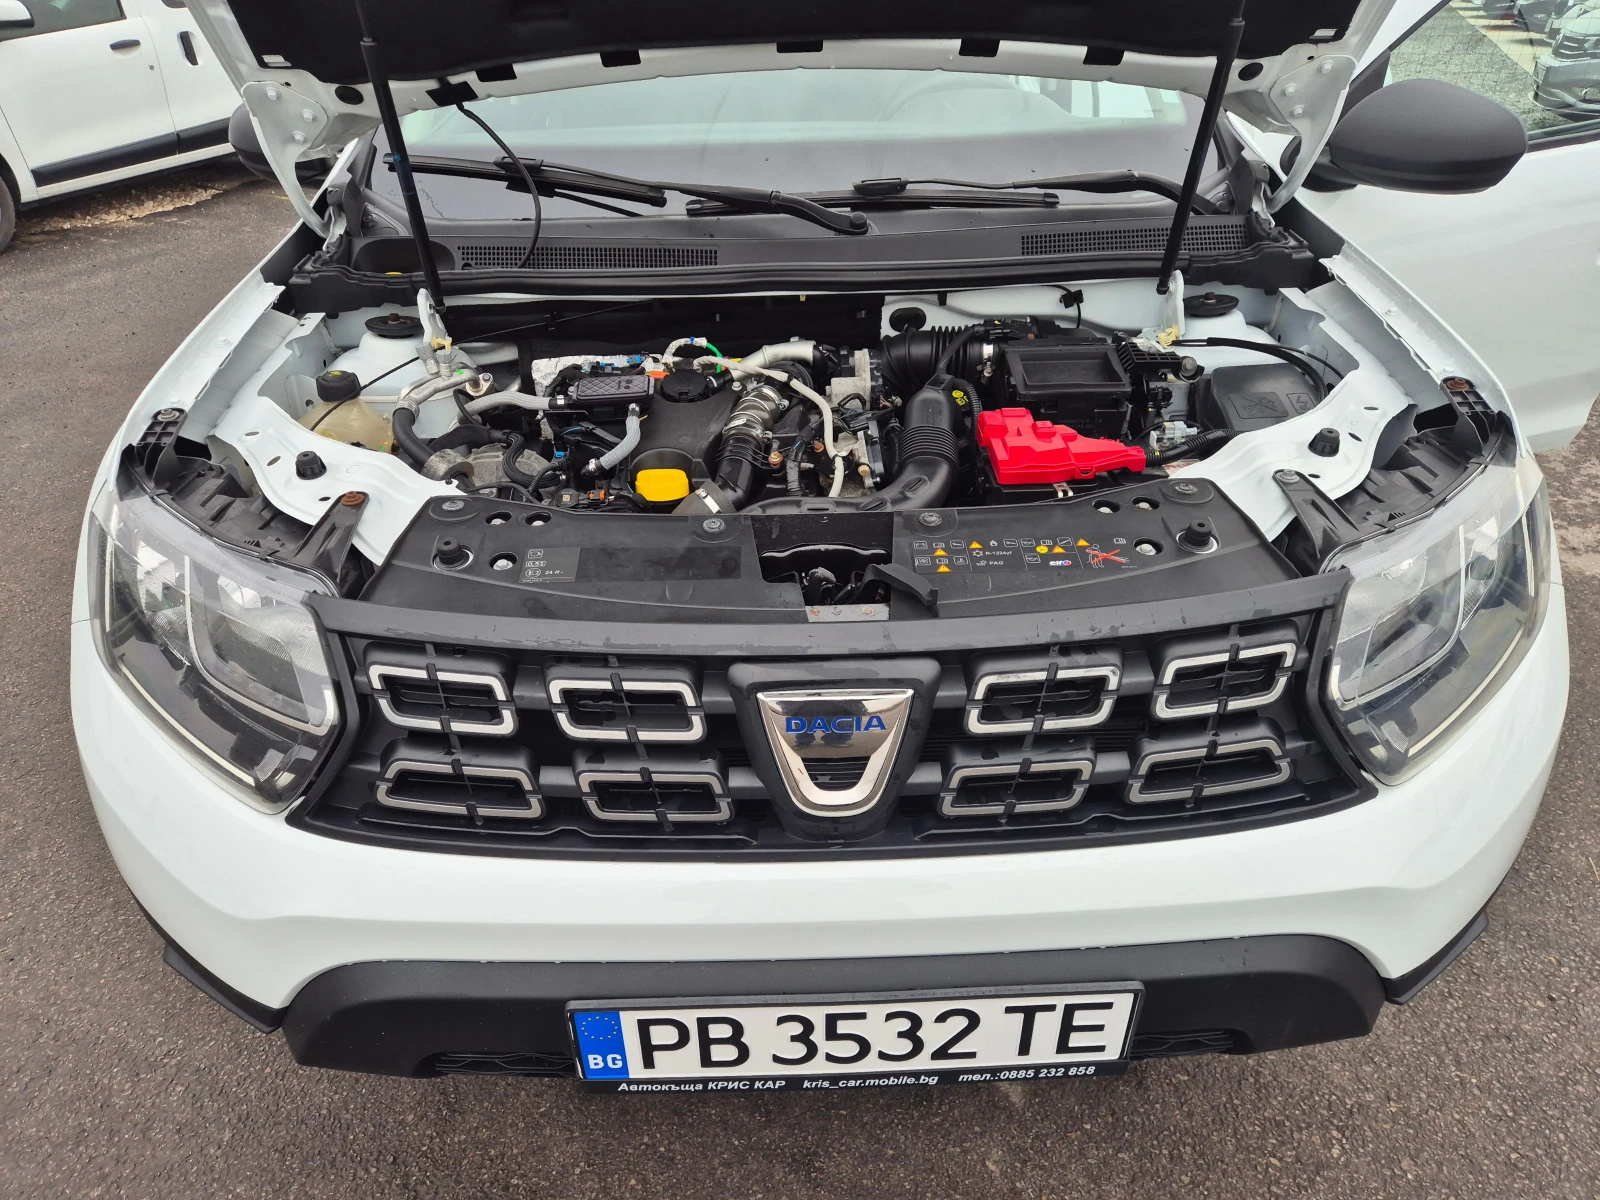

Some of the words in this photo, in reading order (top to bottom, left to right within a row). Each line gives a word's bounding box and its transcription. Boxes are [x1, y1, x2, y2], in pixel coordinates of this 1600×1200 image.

[785, 715, 887, 734] DACIA
[636, 1016, 750, 1070] PB
[772, 1007, 981, 1066] 3532
[1004, 1001, 1114, 1057] TE
[587, 1054, 623, 1070] BG
[803, 1075, 939, 1089] kris_car.mobile.bg
[958, 1069, 1035, 1082] тел.:0885
[1038, 1067, 1065, 1077] 232
[1068, 1066, 1095, 1076] 858
[617, 1083, 703, 1092] Автокъща
[707, 1081, 750, 1090] КРИС
[754, 1080, 786, 1090] КАР
